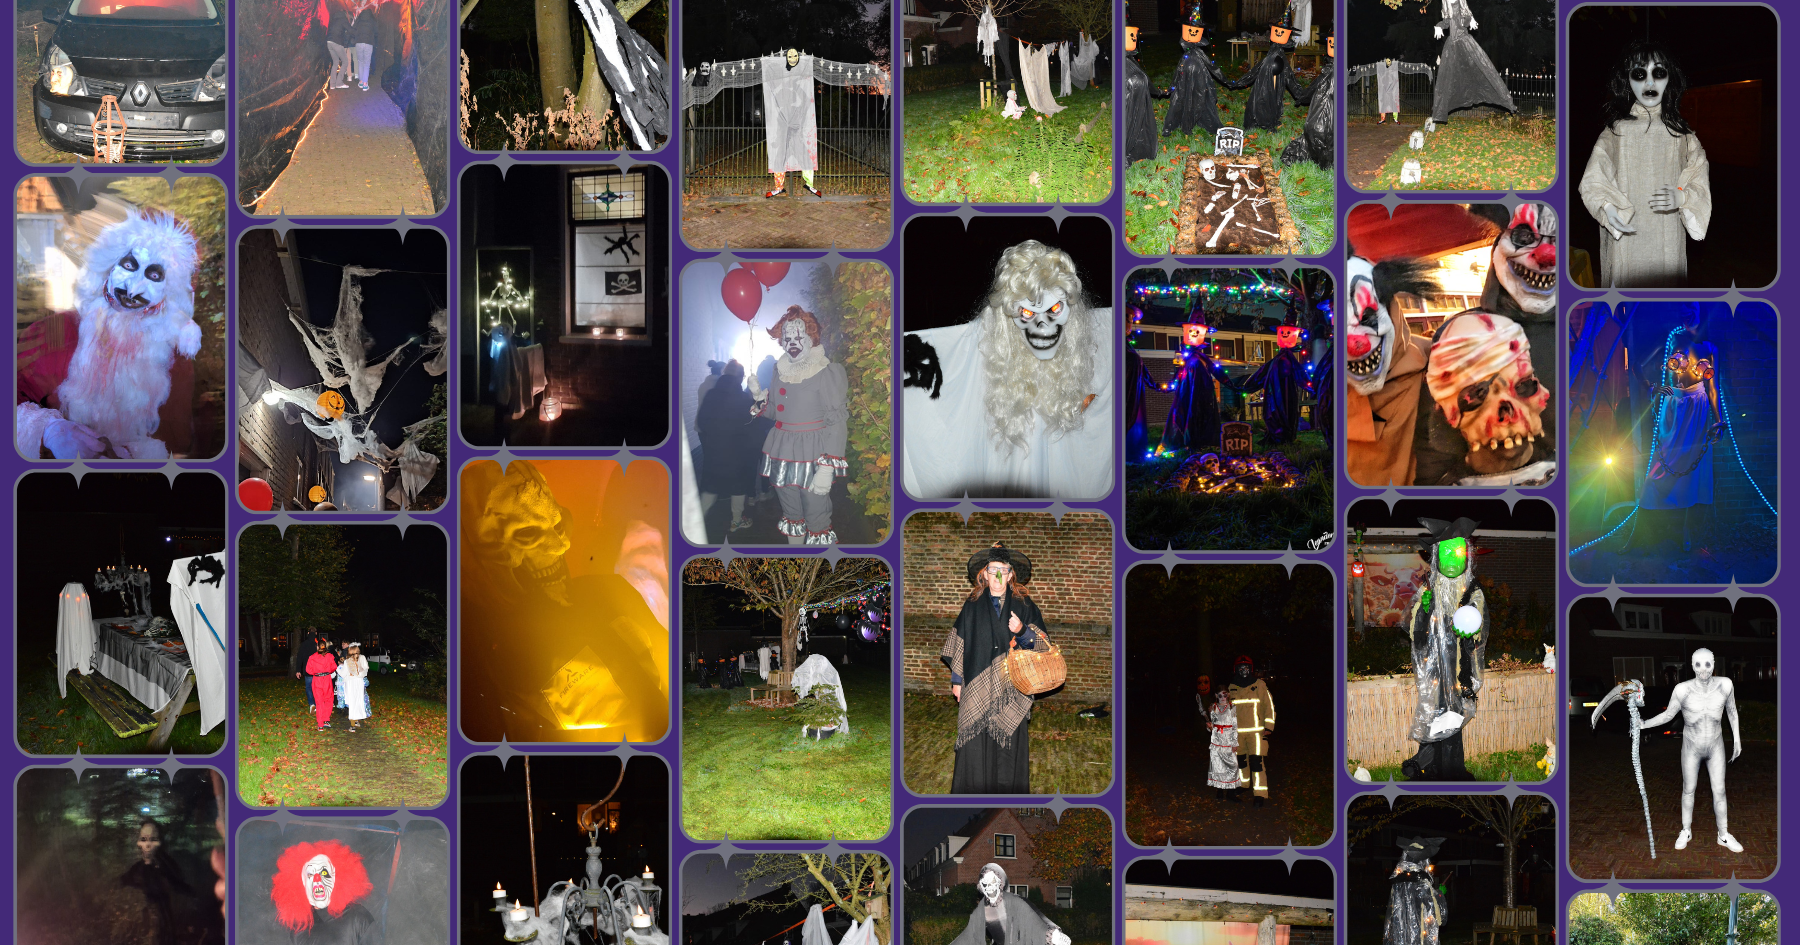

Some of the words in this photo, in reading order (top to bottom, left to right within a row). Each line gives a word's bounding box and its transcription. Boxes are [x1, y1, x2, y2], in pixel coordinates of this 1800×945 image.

[1219, 138, 1240, 149] RIP
[1225, 437, 1249, 451] RIP
[559, 664, 594, 699] FIREWARE
